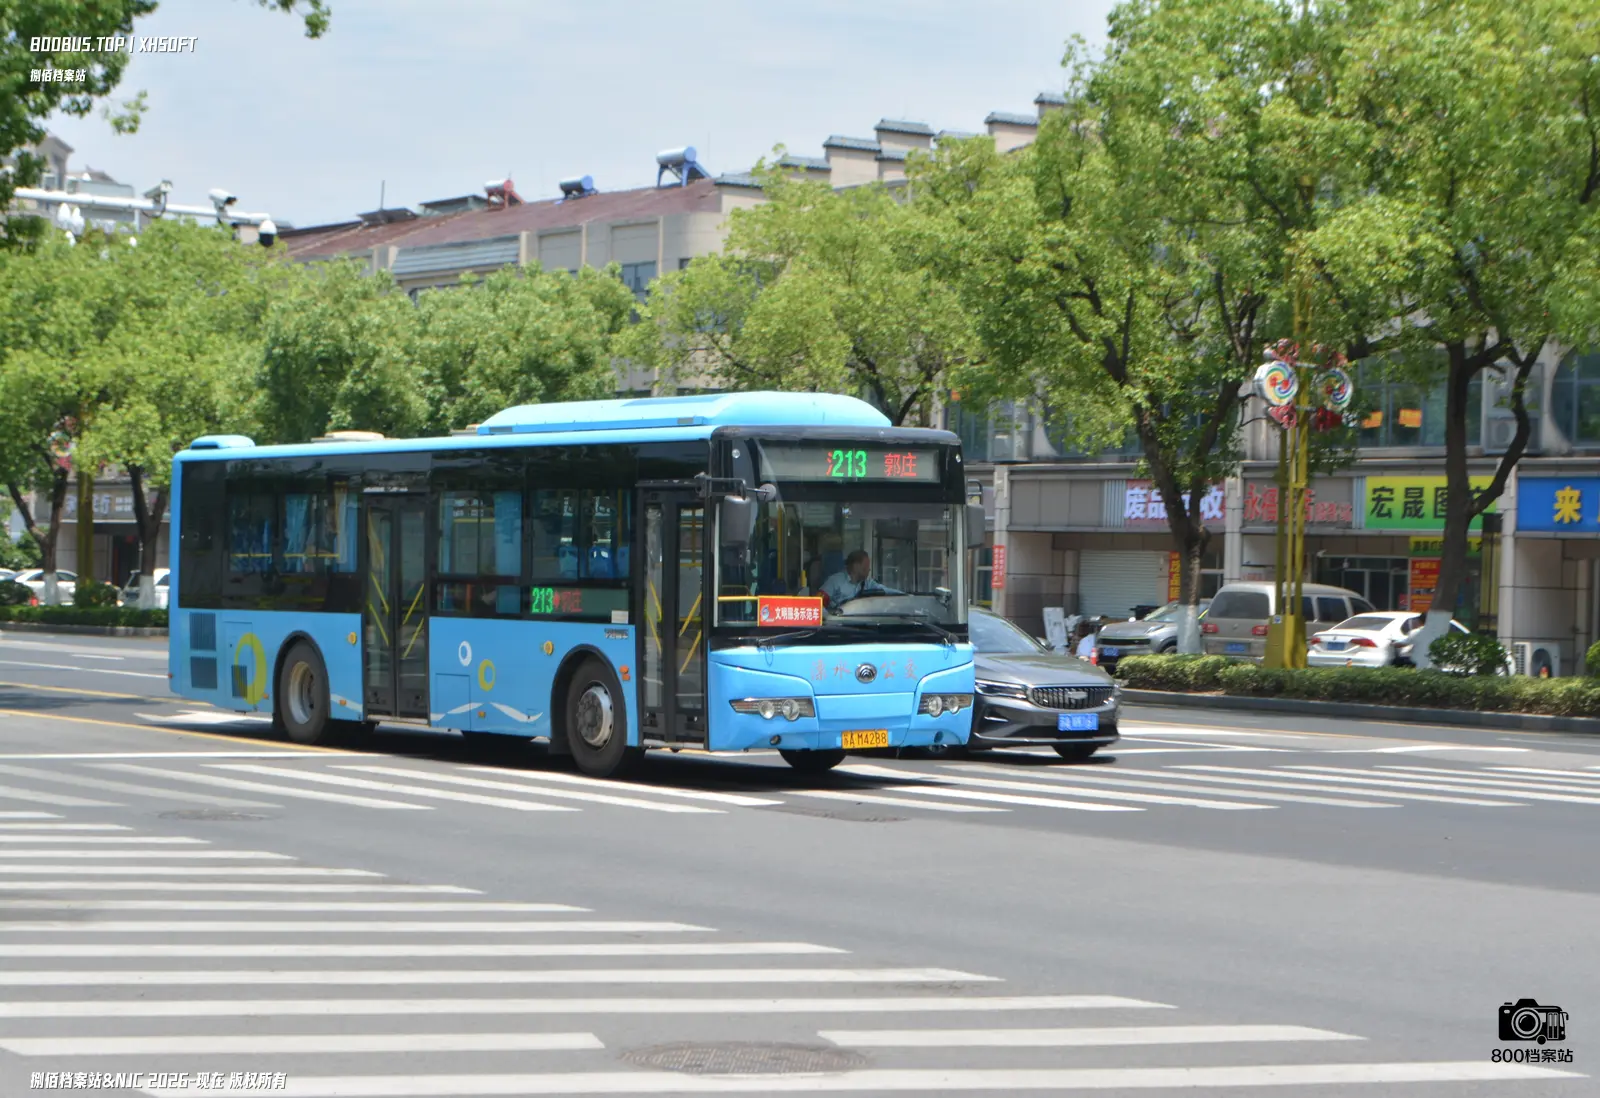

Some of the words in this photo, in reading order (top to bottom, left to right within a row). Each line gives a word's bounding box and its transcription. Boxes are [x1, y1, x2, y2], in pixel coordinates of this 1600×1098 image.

[831, 450, 866, 477] 213
[884, 452, 917, 477] 郭庄
[1124, 486, 1225, 520] 废品收
[1370, 485, 1487, 520] 宏晟图
[1554, 485, 1600, 523] 来
[531, 587, 554, 613] 213
[774, 606, 820, 620] 文明服务示范车
